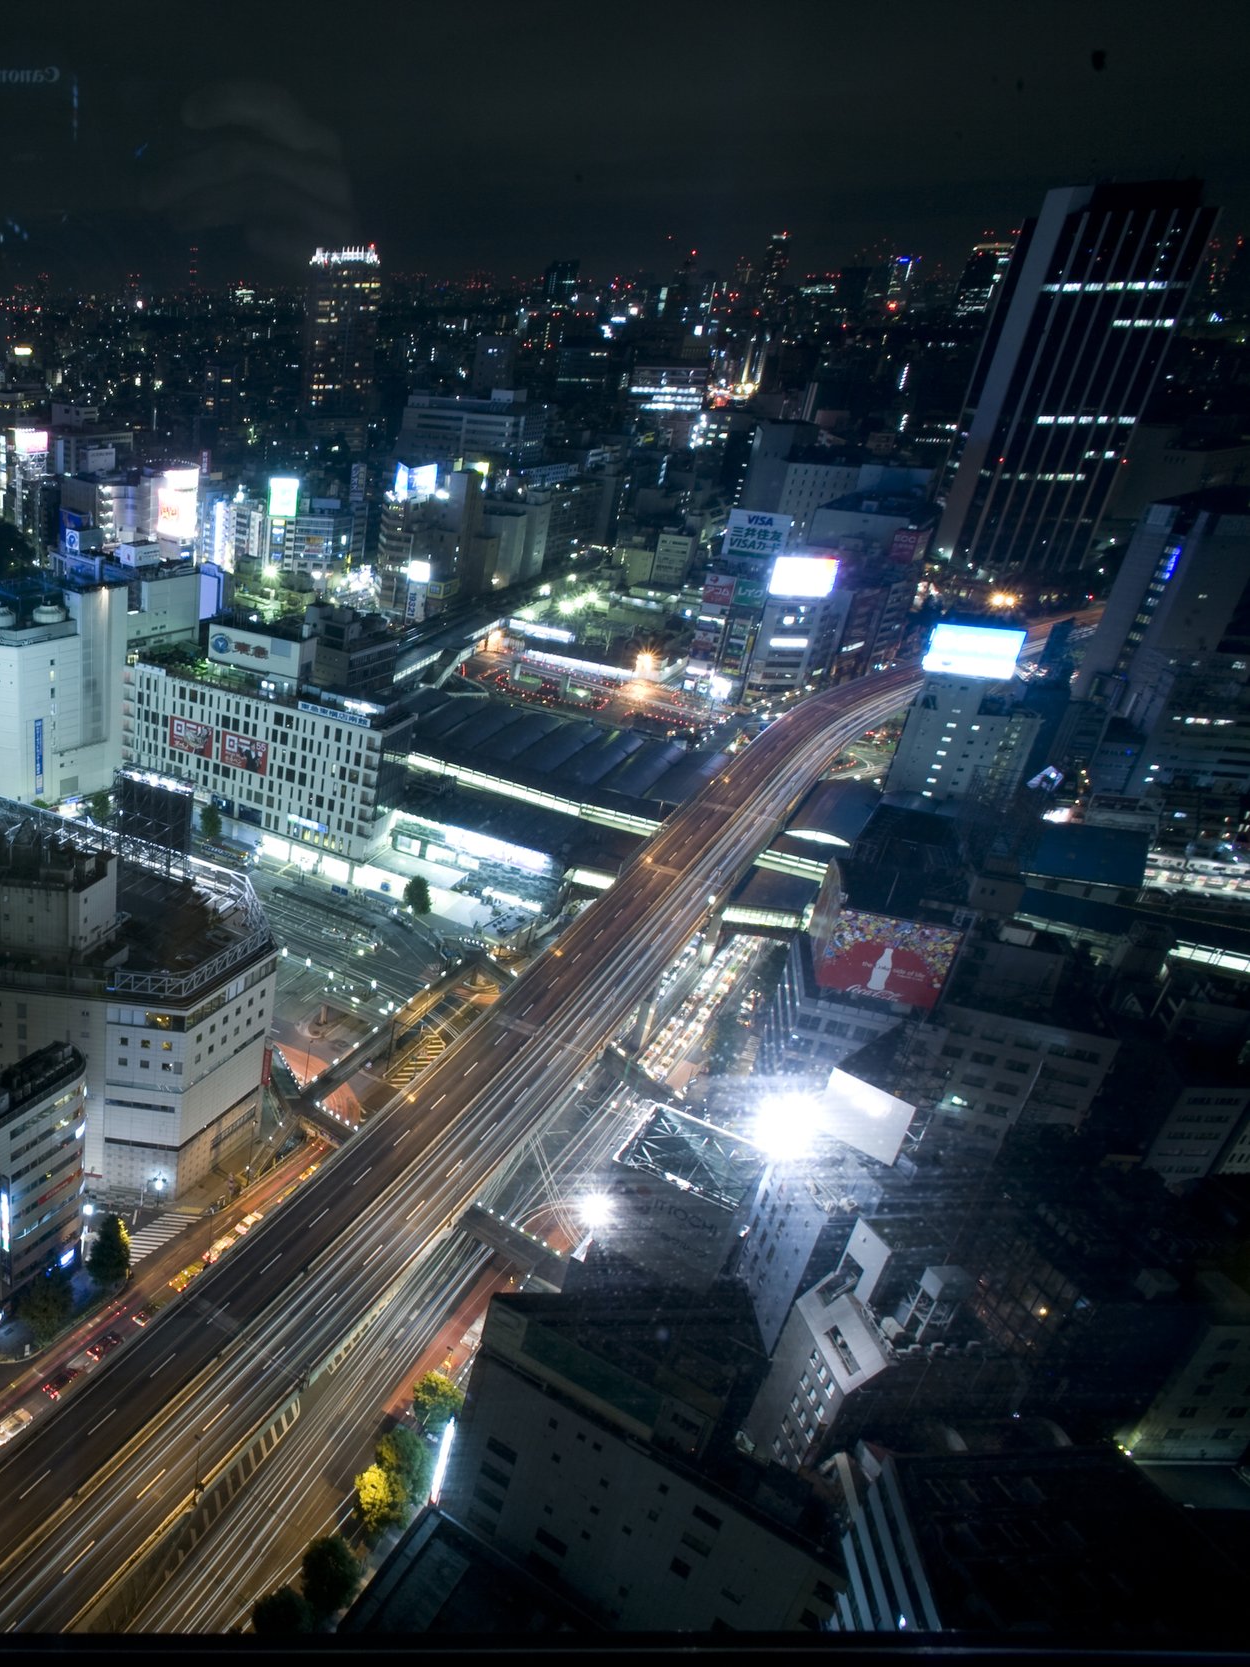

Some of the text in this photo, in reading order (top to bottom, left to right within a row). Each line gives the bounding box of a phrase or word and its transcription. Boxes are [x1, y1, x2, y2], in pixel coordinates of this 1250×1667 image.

[747, 515, 773, 526] VISA
[731, 526, 783, 542] 三井住友
[729, 537, 781, 553] VISAカード
[738, 586, 763, 598] レイク
[232, 641, 269, 660] 東急
[256, 741, 266, 752] 55
